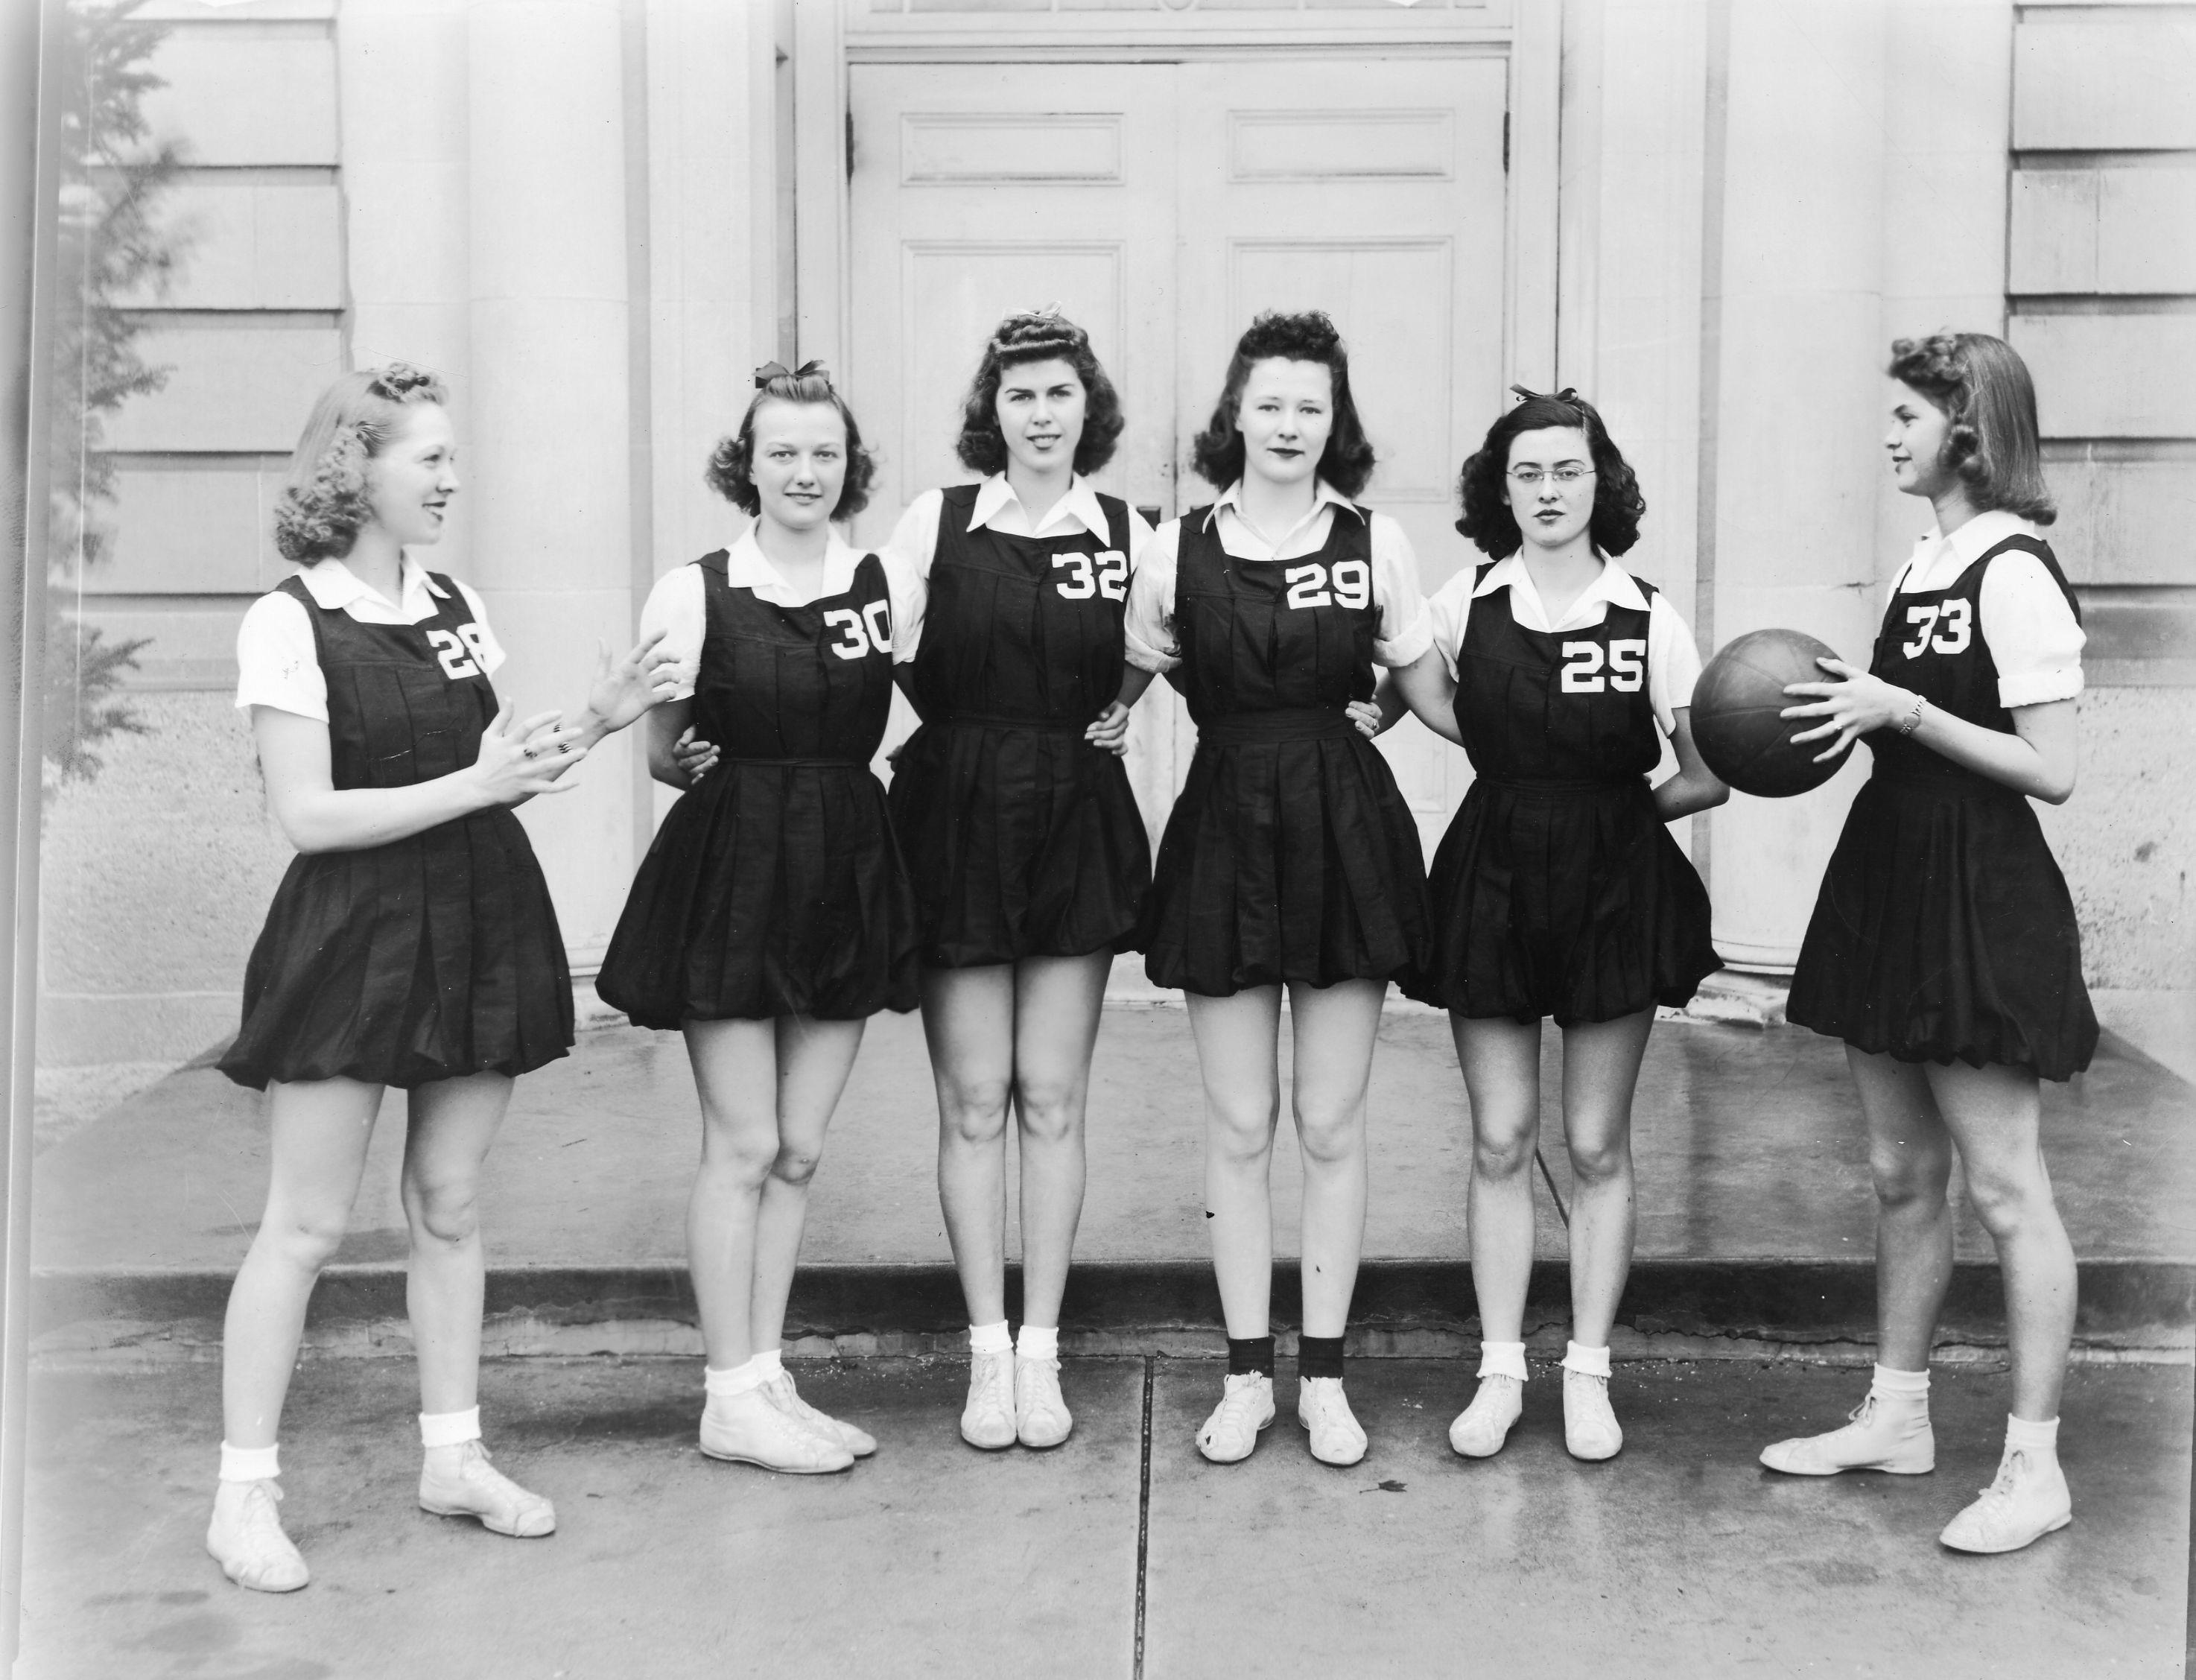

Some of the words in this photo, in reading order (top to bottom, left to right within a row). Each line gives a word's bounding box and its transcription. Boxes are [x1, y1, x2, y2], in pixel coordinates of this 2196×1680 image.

[1052, 551, 1128, 602] 32
[1286, 560, 1369, 609] 29
[823, 598, 892, 660] 30
[1903, 597, 1972, 659] 33
[1561, 639, 1646, 693] 25
